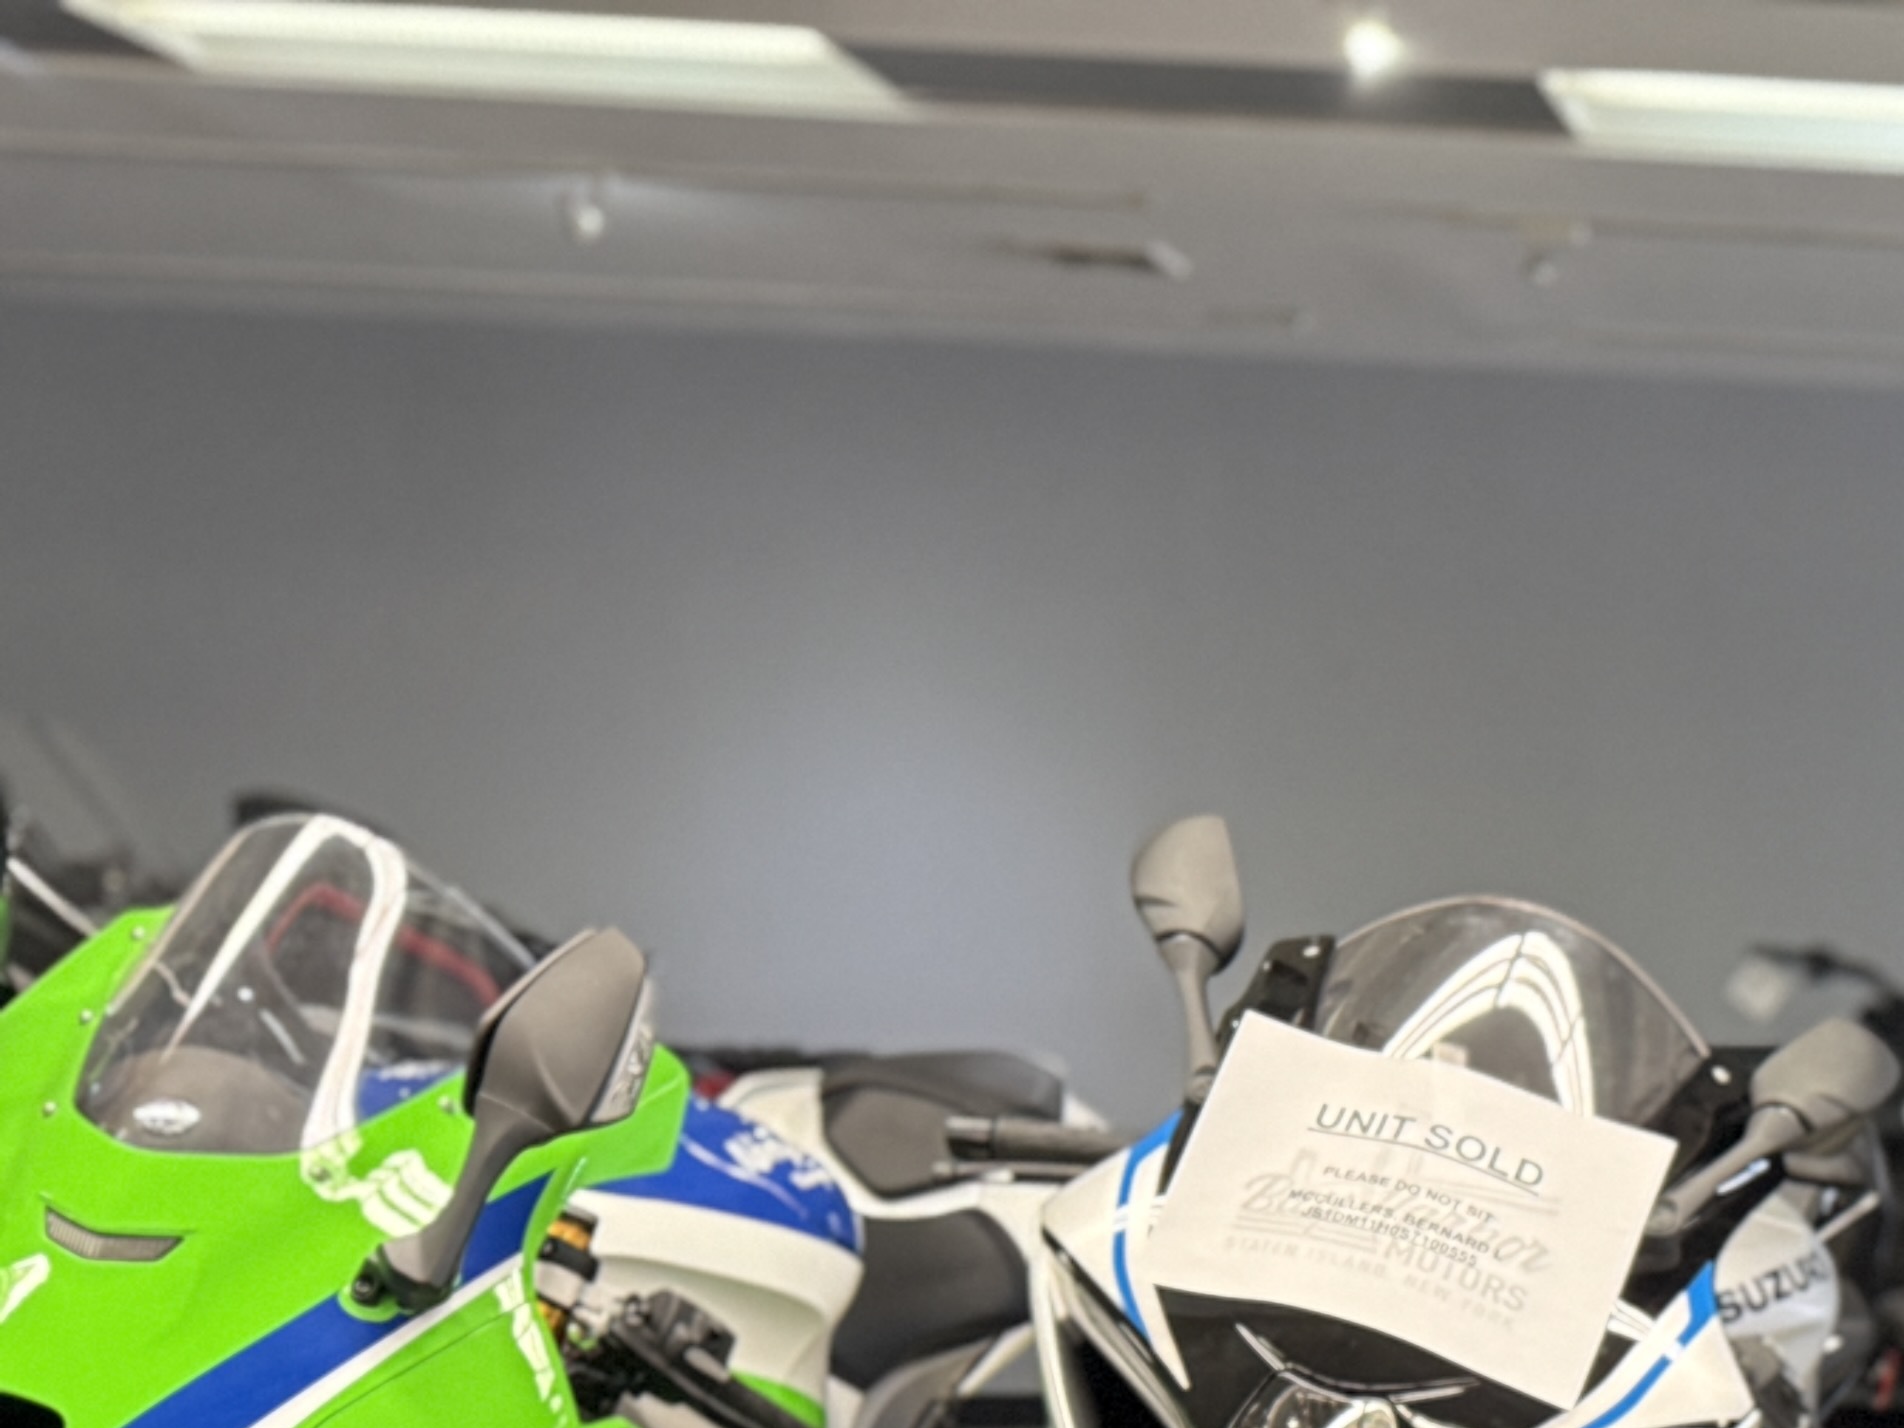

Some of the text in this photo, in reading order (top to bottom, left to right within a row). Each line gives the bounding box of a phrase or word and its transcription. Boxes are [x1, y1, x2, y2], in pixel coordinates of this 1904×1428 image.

[1315, 1102, 1546, 1187] UNIT SOLD
[1322, 1165, 1495, 1224] PLEASE DO NOT SIT
[1716, 1250, 1828, 1324] SUZUK
